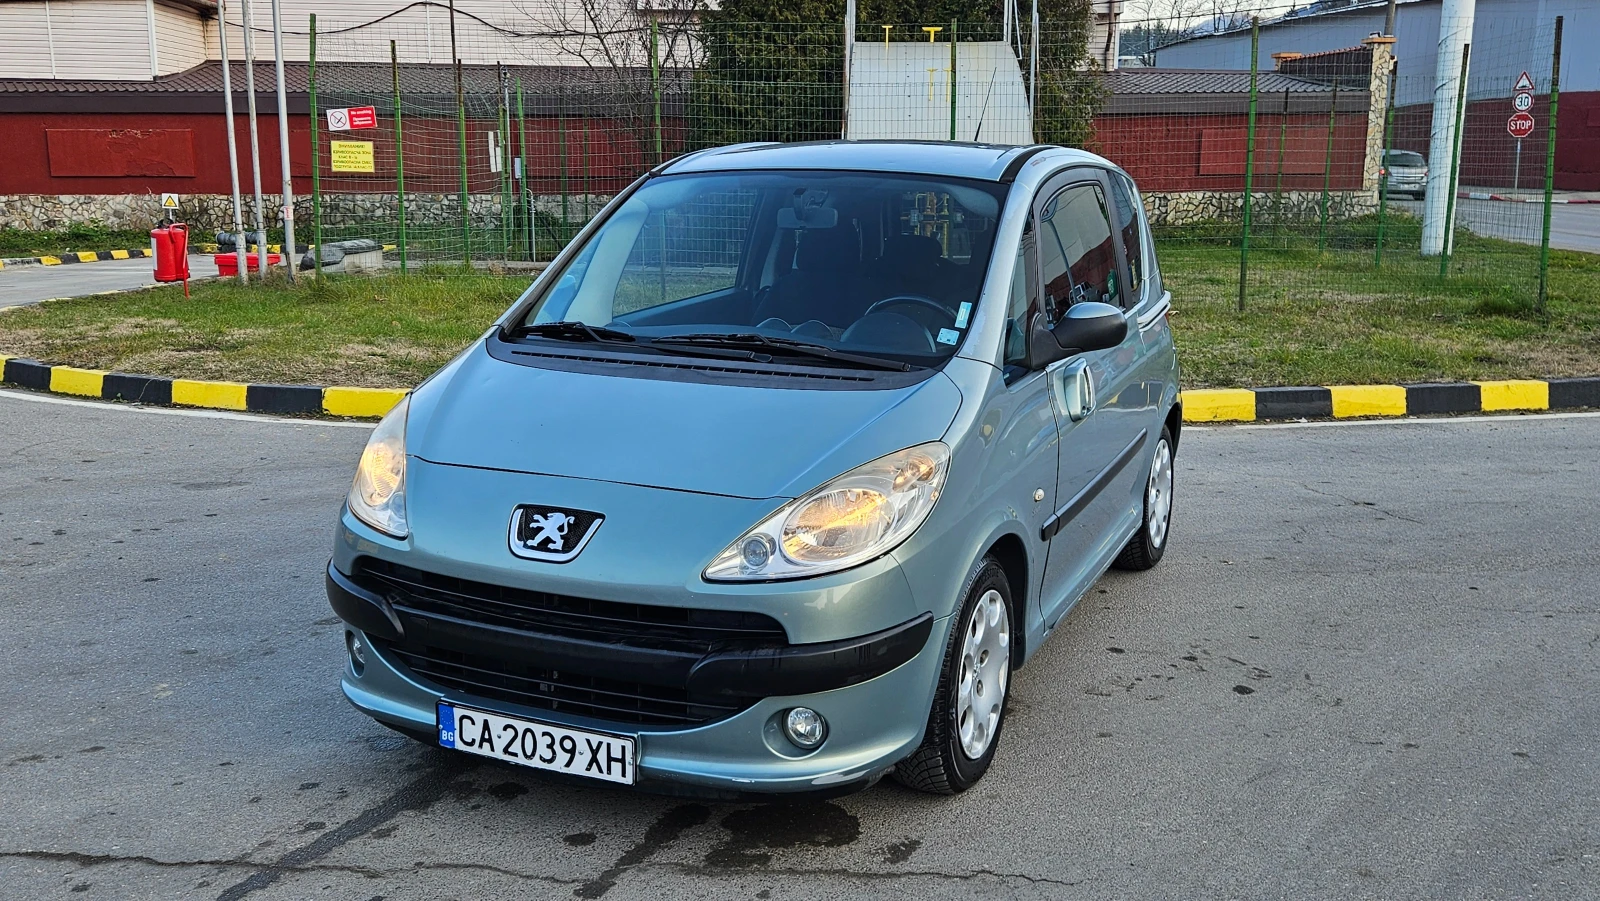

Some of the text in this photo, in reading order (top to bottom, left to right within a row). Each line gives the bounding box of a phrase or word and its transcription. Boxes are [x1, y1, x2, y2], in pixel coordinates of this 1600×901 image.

[1516, 96, 1530, 107] 30
[1510, 120, 1531, 130] STOP
[441, 729, 454, 742] BG
[458, 714, 627, 778] CA 2039 XH
